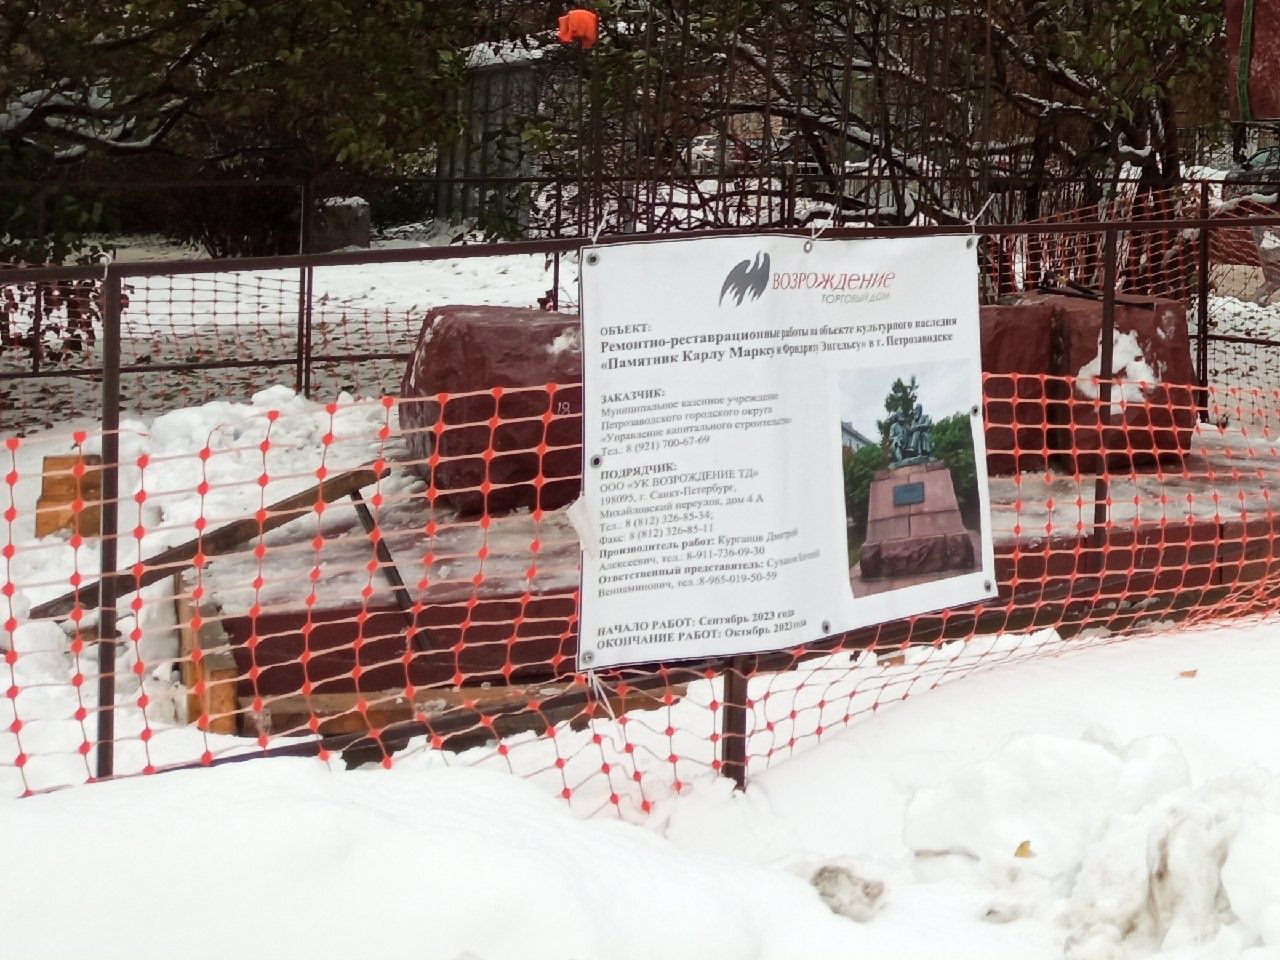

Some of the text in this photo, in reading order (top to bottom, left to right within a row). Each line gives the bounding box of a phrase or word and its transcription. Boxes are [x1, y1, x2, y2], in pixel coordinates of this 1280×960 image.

[821, 291, 891, 304] ТОРГОВЫЙ ДОМ
[600, 323, 652, 336] ОБЪЕКТ:
[600, 329, 780, 354] Ремонтно-реставрационные
[781, 327, 809, 340] работы
[819, 324, 855, 336] объекте
[856, 320, 913, 335] культурного
[915, 317, 958, 329] наследия
[600, 355, 679, 370] «Памятник
[682, 349, 726, 363] Карлу
[729, 346, 776, 361] Марксу
[876, 339, 885, 347] г.
[886, 332, 954, 348] Петрозаводске
[600, 388, 666, 404] ЗАКАЗЧИК:
[600, 401, 679, 418] Муниципальное
[681, 397, 725, 409] казенное
[600, 405, 773, 431] Петрозаводского городского округа
[600, 427, 664, 444] «Управление
[666, 421, 732, 437] капитального
[625, 443, 632, 453] 8
[634, 440, 661, 454] (921)
[663, 435, 710, 449] 700-67-69
[600, 461, 678, 480] ПОДРЯДЧИК:
[600, 467, 759, 493] ООО «УК ВОЗРОЖДЕНИЕ ТД»
[600, 493, 637, 506] 198095,
[650, 483, 738, 501] Санкт-Петербург,
[600, 493, 764, 520] Михайловский переулок, дом 4 А
[625, 519, 631, 528] 8
[633, 515, 660, 530] (812)
[599, 524, 714, 546] Факс: 8 (812) 326-85-11
[599, 540, 680, 559] Производитель
[681, 536, 715, 550] работ:
[717, 533, 764, 548] Курганов
[598, 555, 659, 572] Алексеевич,
[686, 546, 766, 561] 8-911-736-09-30
[598, 565, 682, 585] Ответственный
[684, 559, 765, 576] представитель:
[597, 608, 796, 637] НАЧАЛО РАБОТ: Сентябрь 2023 года
[597, 632, 675, 650] ОКОНЧАНИЕ
[678, 628, 722, 641] РАБОТ:
[724, 624, 771, 639] Октябрь
[773, 622, 793, 634] 2023
